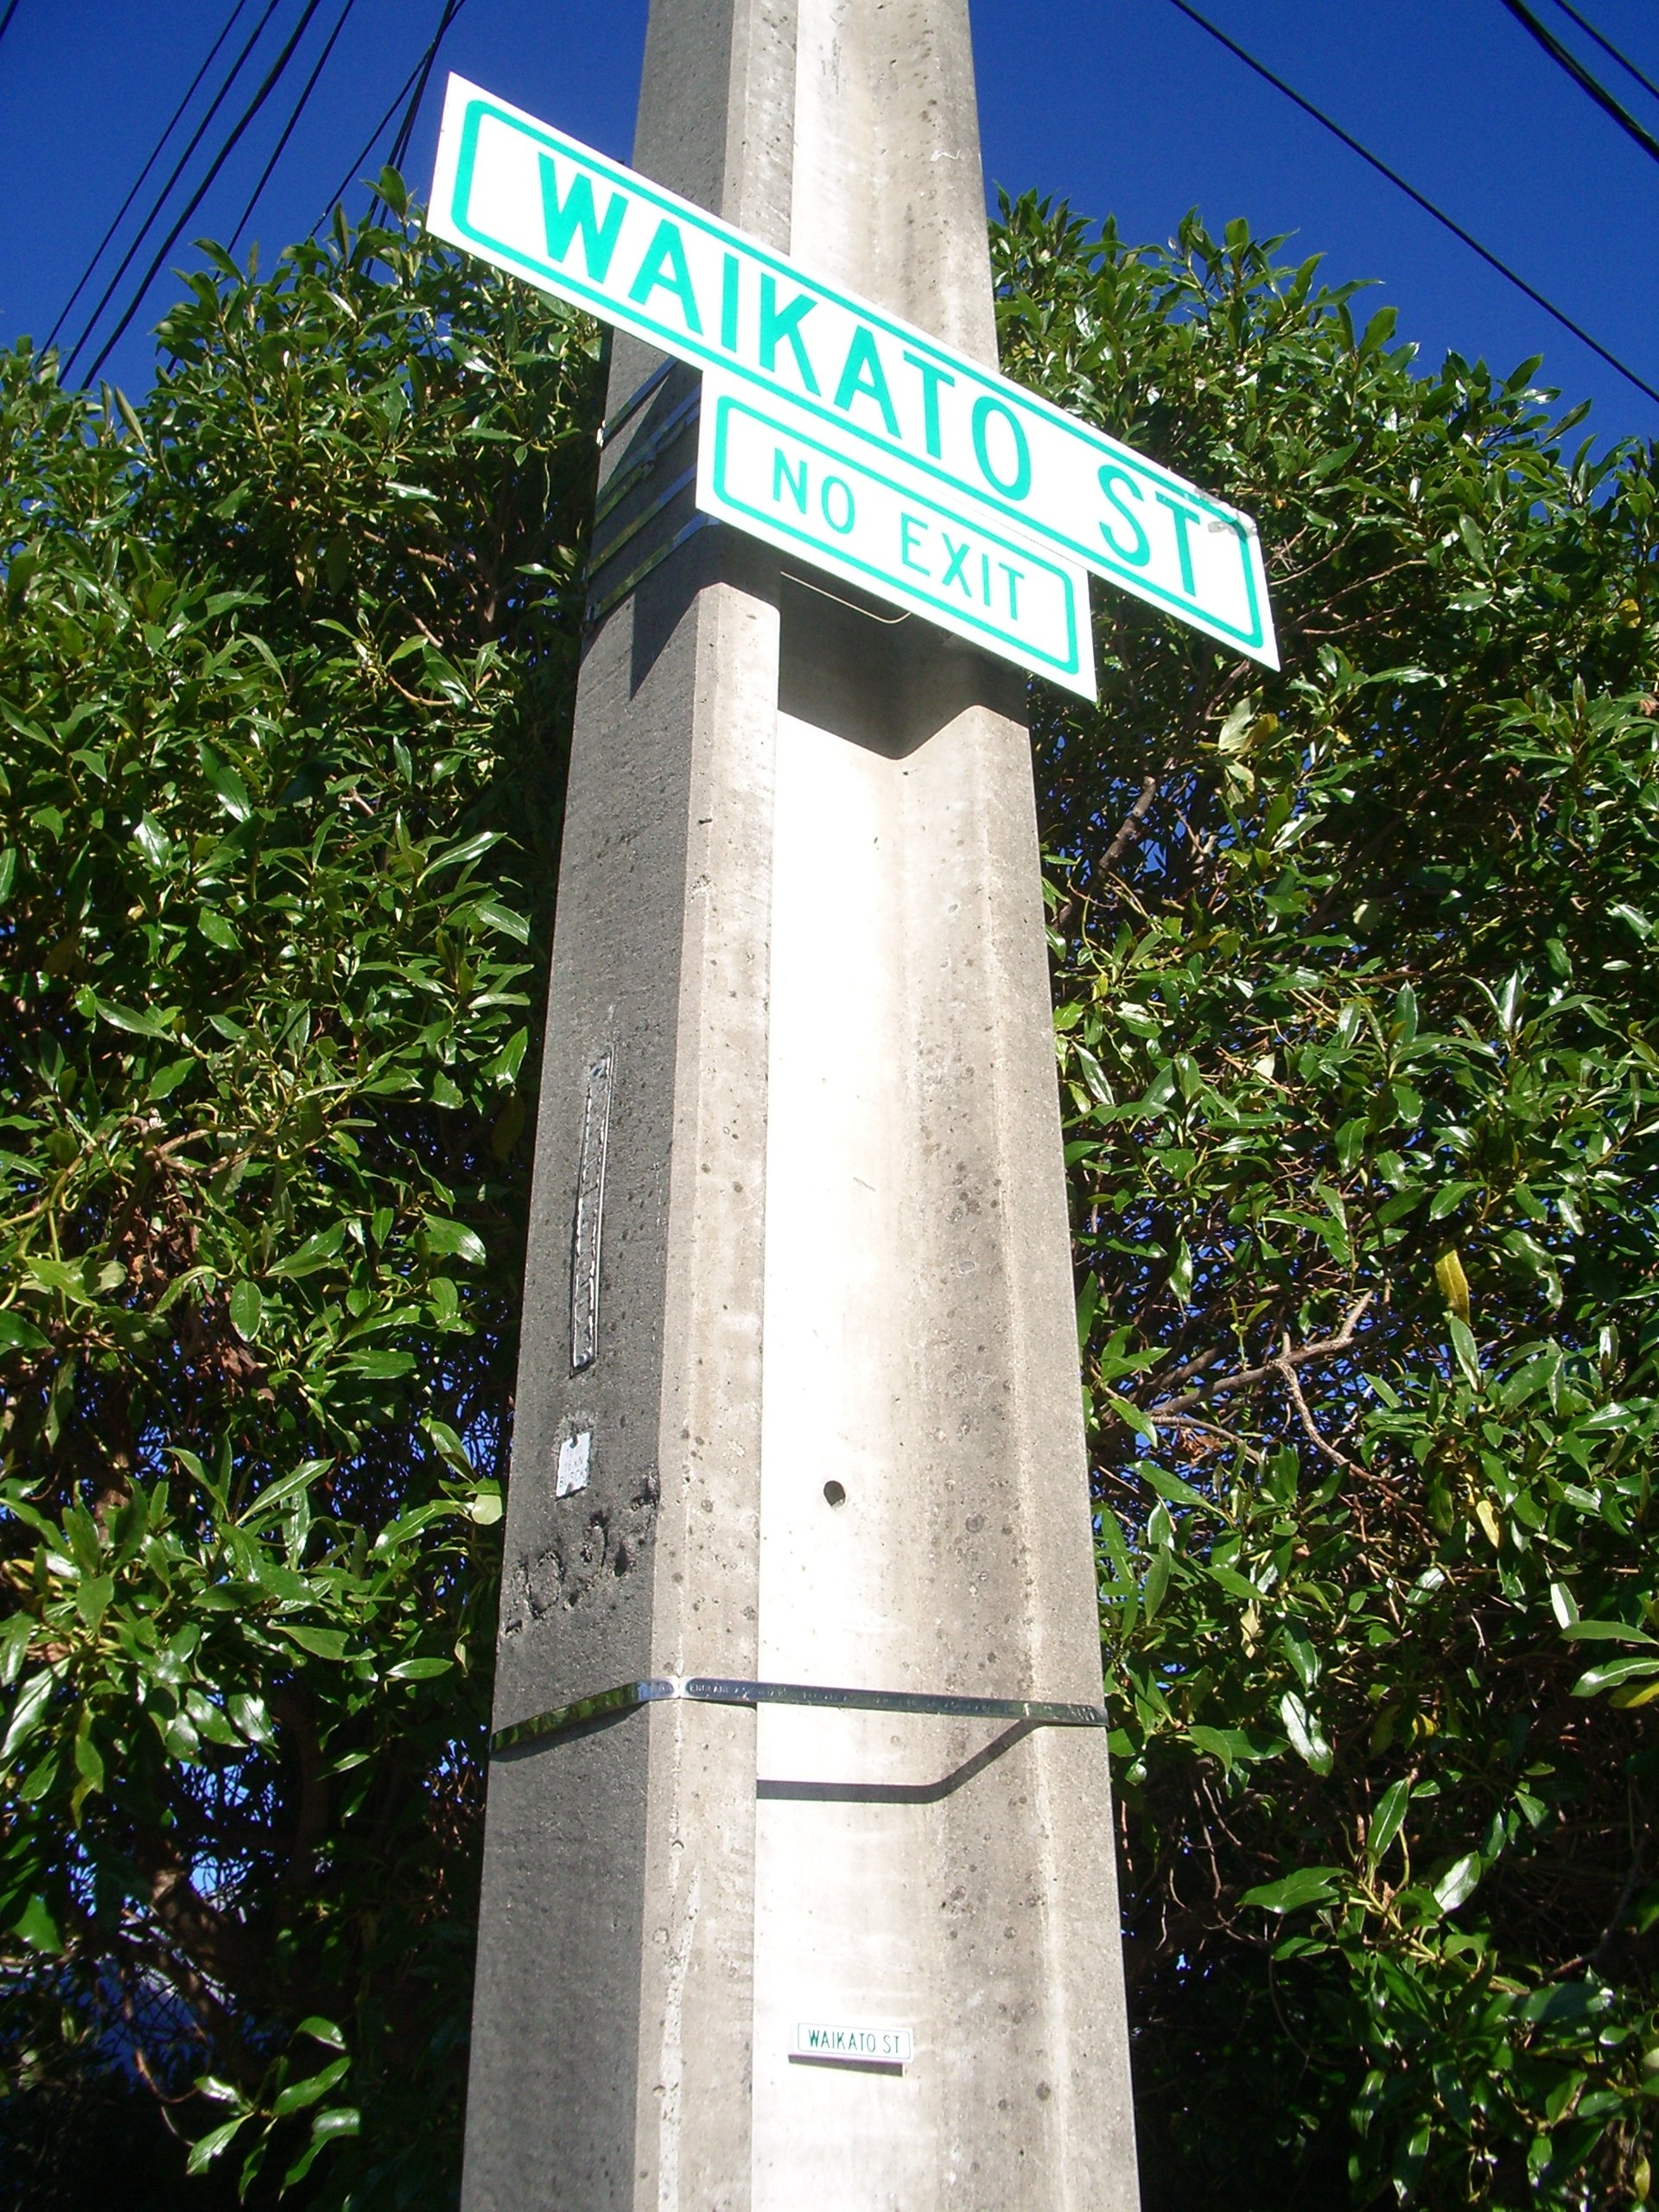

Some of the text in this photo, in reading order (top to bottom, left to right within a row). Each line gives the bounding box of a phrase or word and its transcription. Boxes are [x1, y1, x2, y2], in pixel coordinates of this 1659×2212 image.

[537, 152, 1200, 597] WAIKATO ST
[772, 448, 1025, 620] NO EXIT
[808, 2029, 899, 2054] WAIKATO ST
